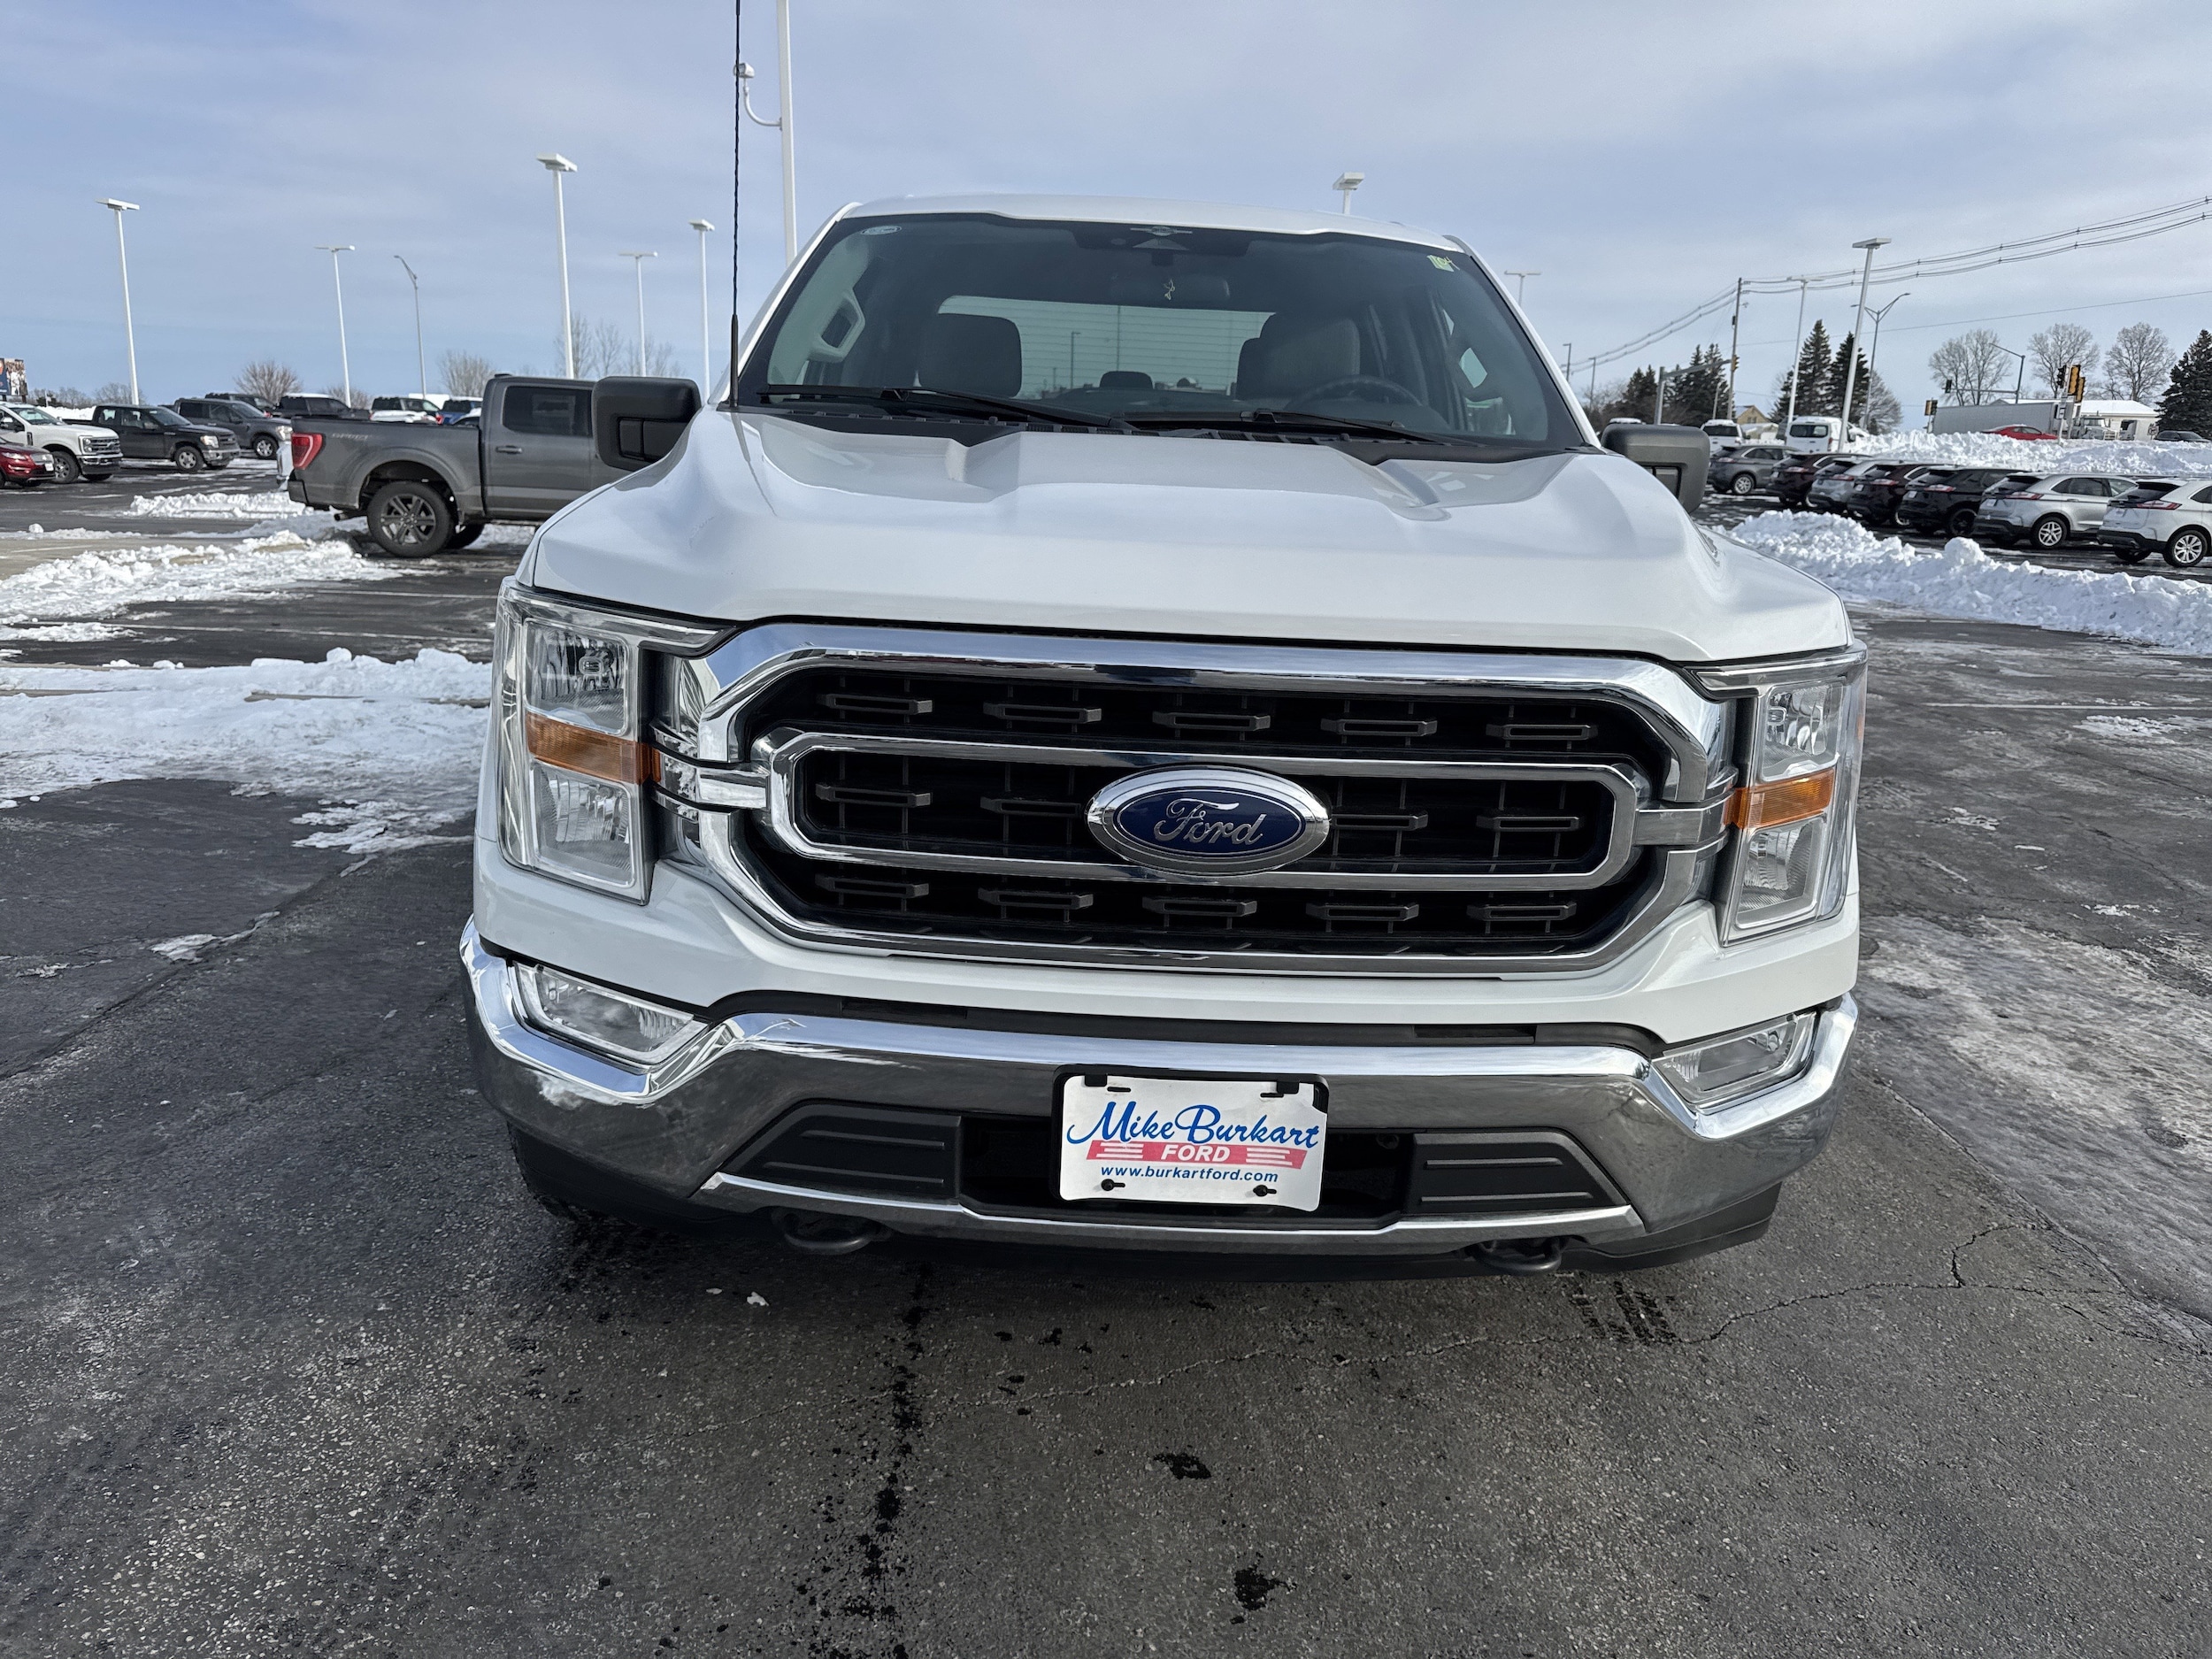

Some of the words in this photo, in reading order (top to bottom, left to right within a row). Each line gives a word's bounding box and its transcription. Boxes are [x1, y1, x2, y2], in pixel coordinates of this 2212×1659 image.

[1153, 797, 1267, 846] Ford
[1066, 1101, 1175, 1144] Mike
[1174, 1104, 1320, 1148] Burkart
[1160, 1144, 1231, 1163] FORD
[1101, 1165, 1279, 1183] www.burkartford.com
